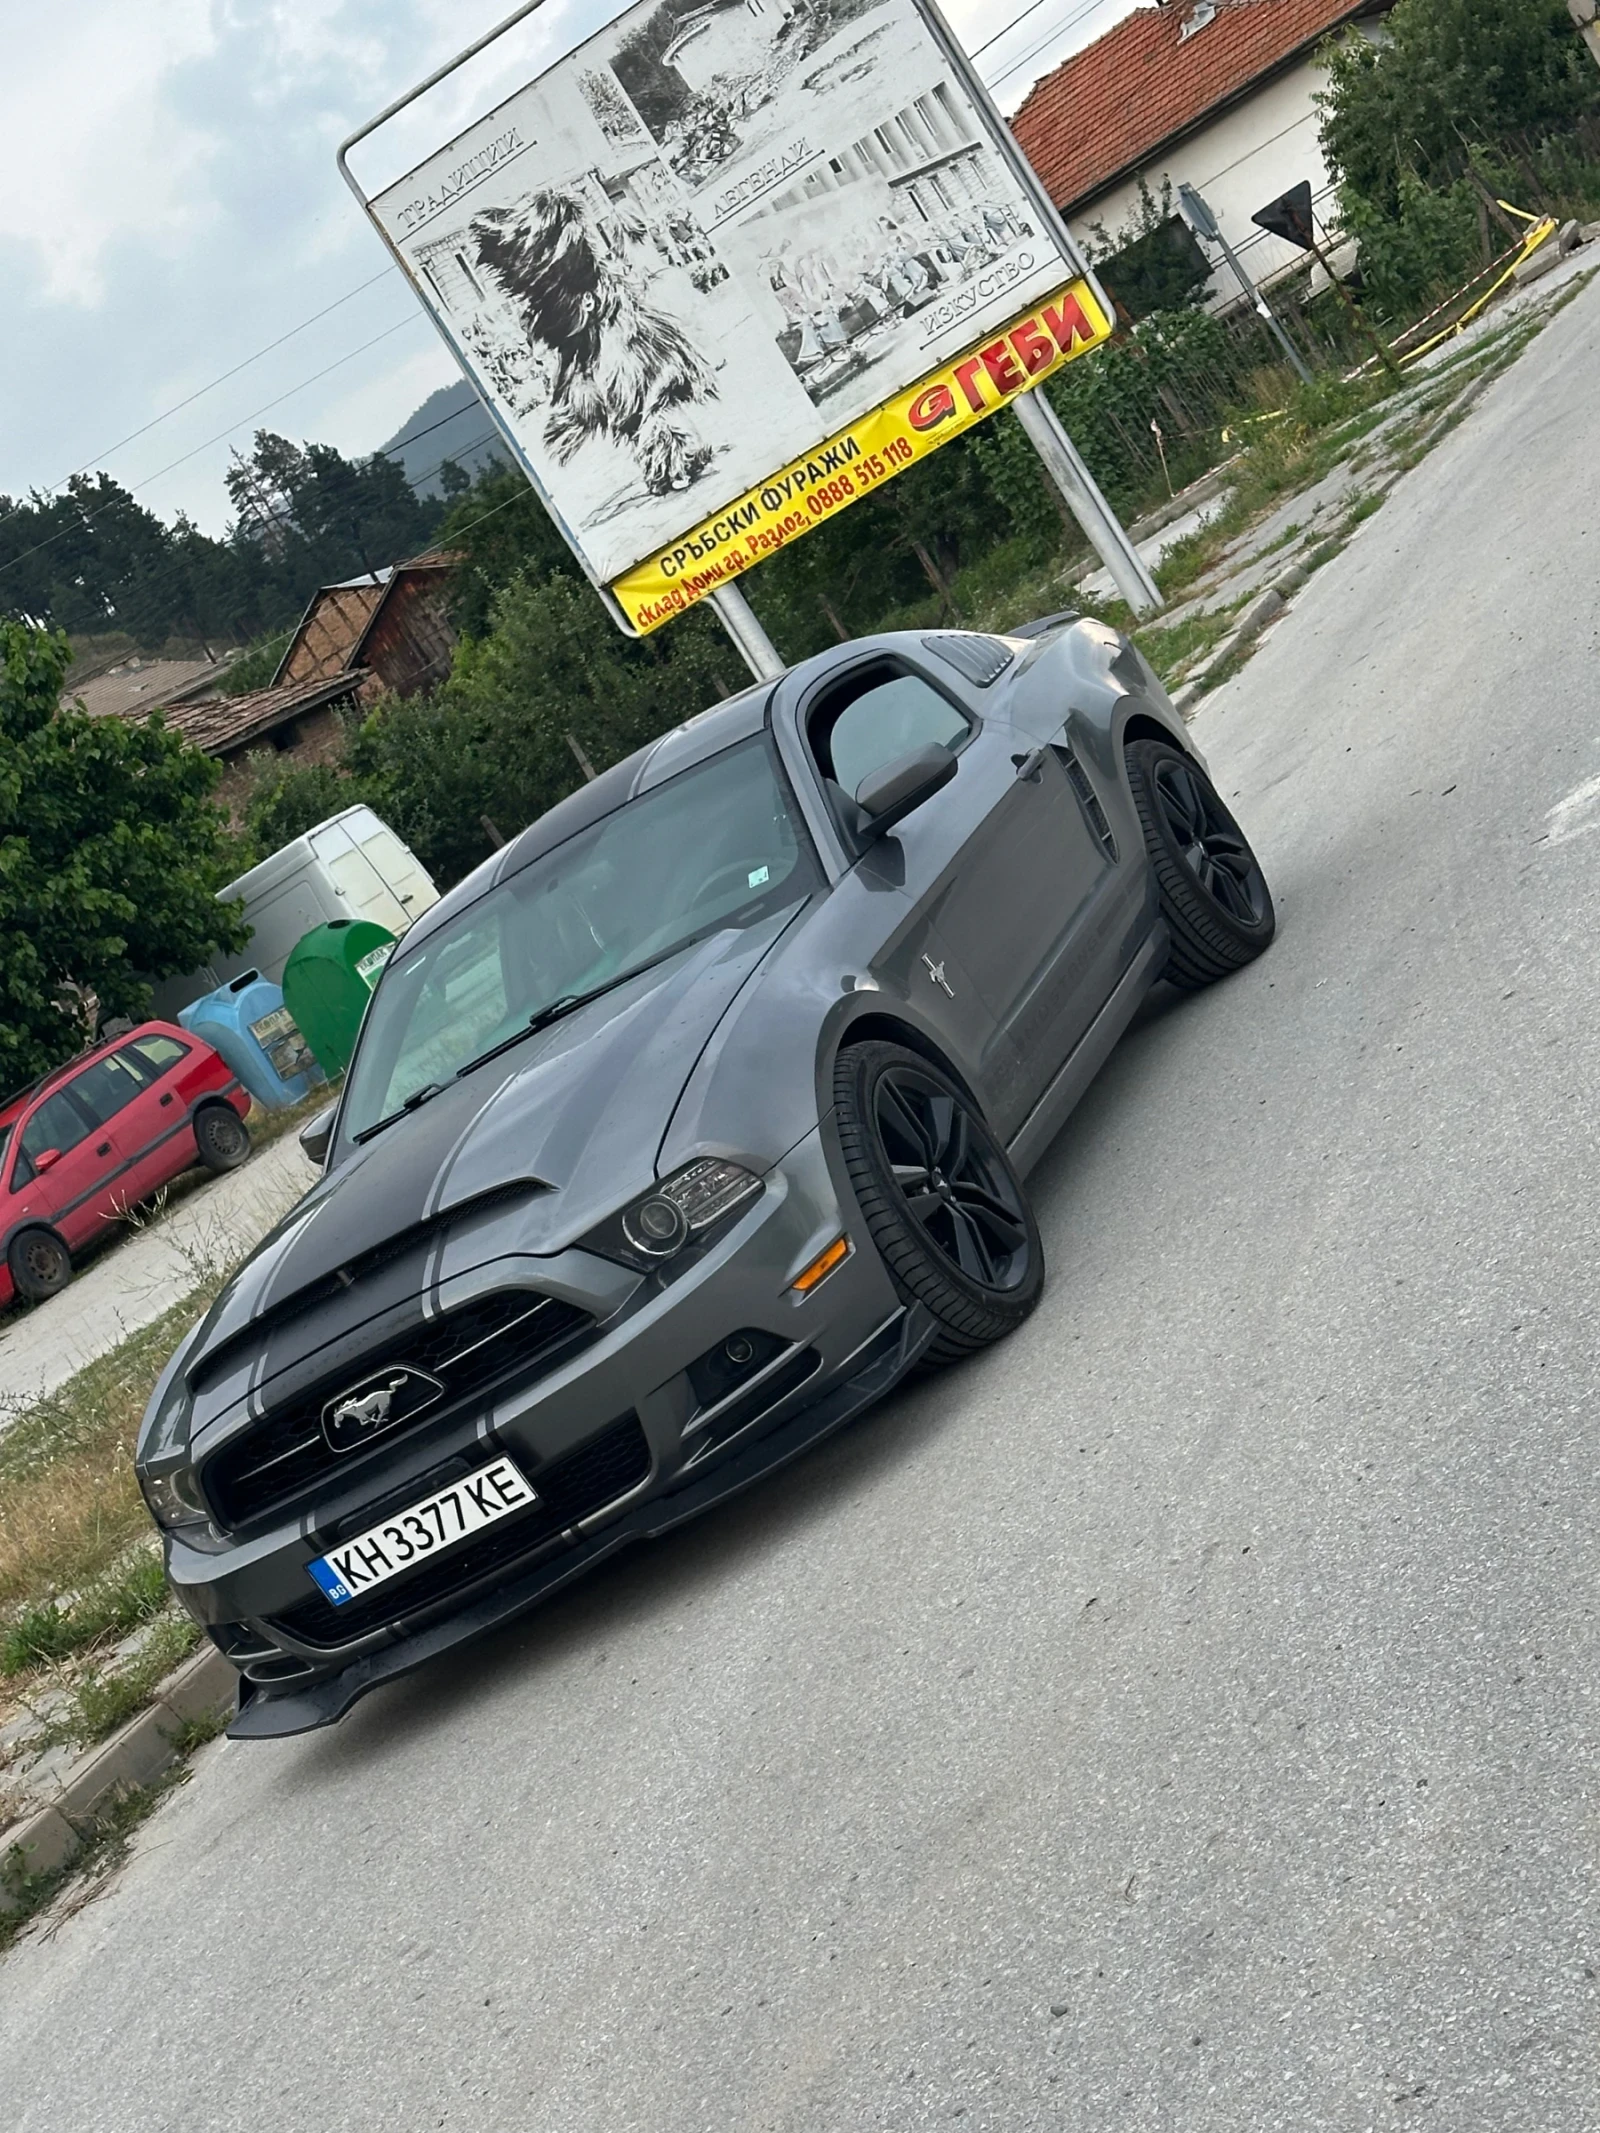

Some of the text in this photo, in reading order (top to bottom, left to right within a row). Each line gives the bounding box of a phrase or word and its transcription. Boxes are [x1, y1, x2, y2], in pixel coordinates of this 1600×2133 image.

[397, 127, 524, 228] ТРАДИЦИИ
[715, 137, 813, 220] ЛЕГЕНДИ
[919, 252, 1035, 336] ИЗКУСТВО
[953, 292, 1096, 413] ГЕБИ
[660, 436, 861, 578] СРЪБСКИ ФУРАЖИ
[723, 549, 750, 573] гр.
[746, 511, 811, 555] Разлог,
[806, 475, 855, 515] 0888
[853, 455, 886, 486] 515
[882, 437, 913, 465] 118
[332, 1465, 526, 1589] KH 3377 KE
[328, 1584, 347, 1600] BG
